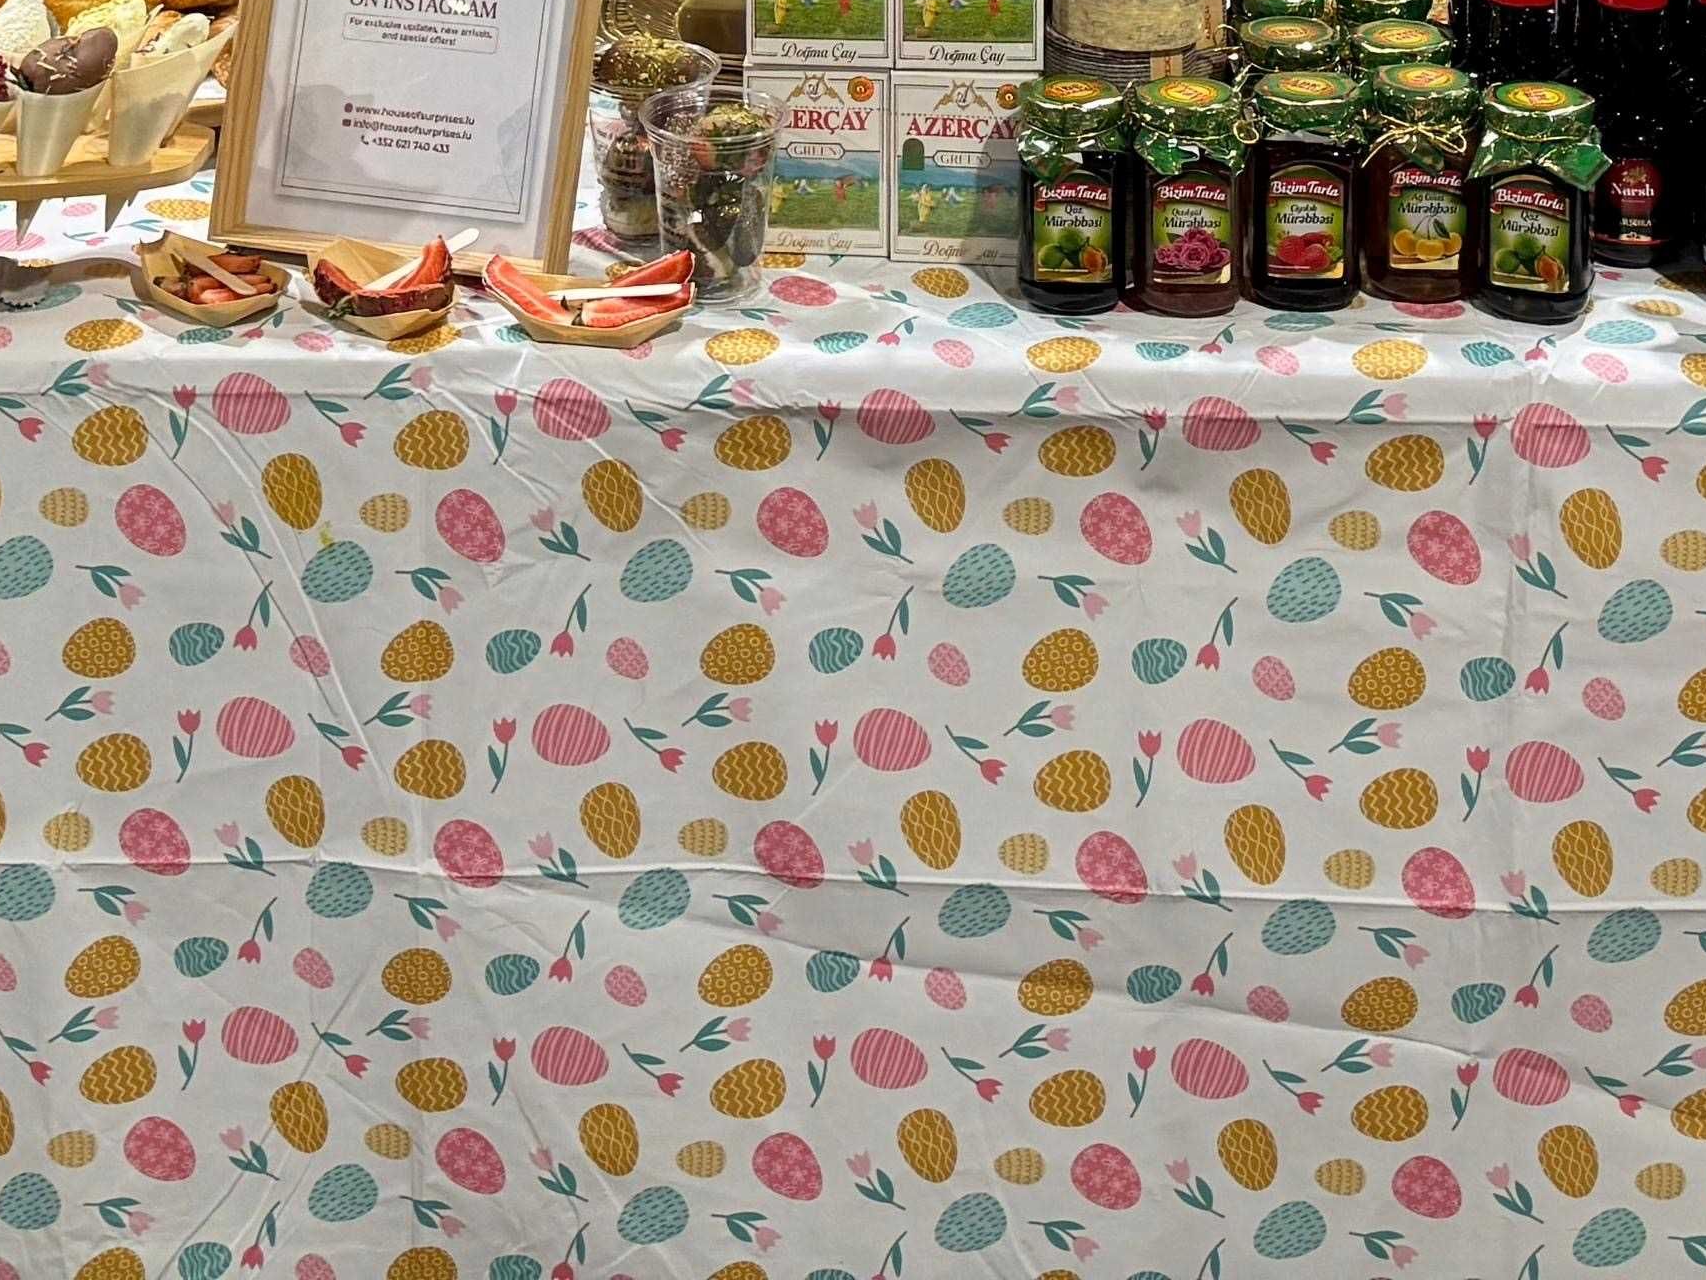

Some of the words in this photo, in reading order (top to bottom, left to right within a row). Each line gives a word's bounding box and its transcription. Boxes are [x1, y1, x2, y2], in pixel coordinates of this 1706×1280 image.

[1158, 186, 1195, 200] Bizim
[1196, 185, 1226, 201] Tarla
[1271, 180, 1307, 195] Bizim
[1307, 181, 1339, 197] Tarla
[1611, 182, 1654, 197] Narsh
[1495, 189, 1532, 205] Bizim
[1534, 191, 1566, 211] Tarla
